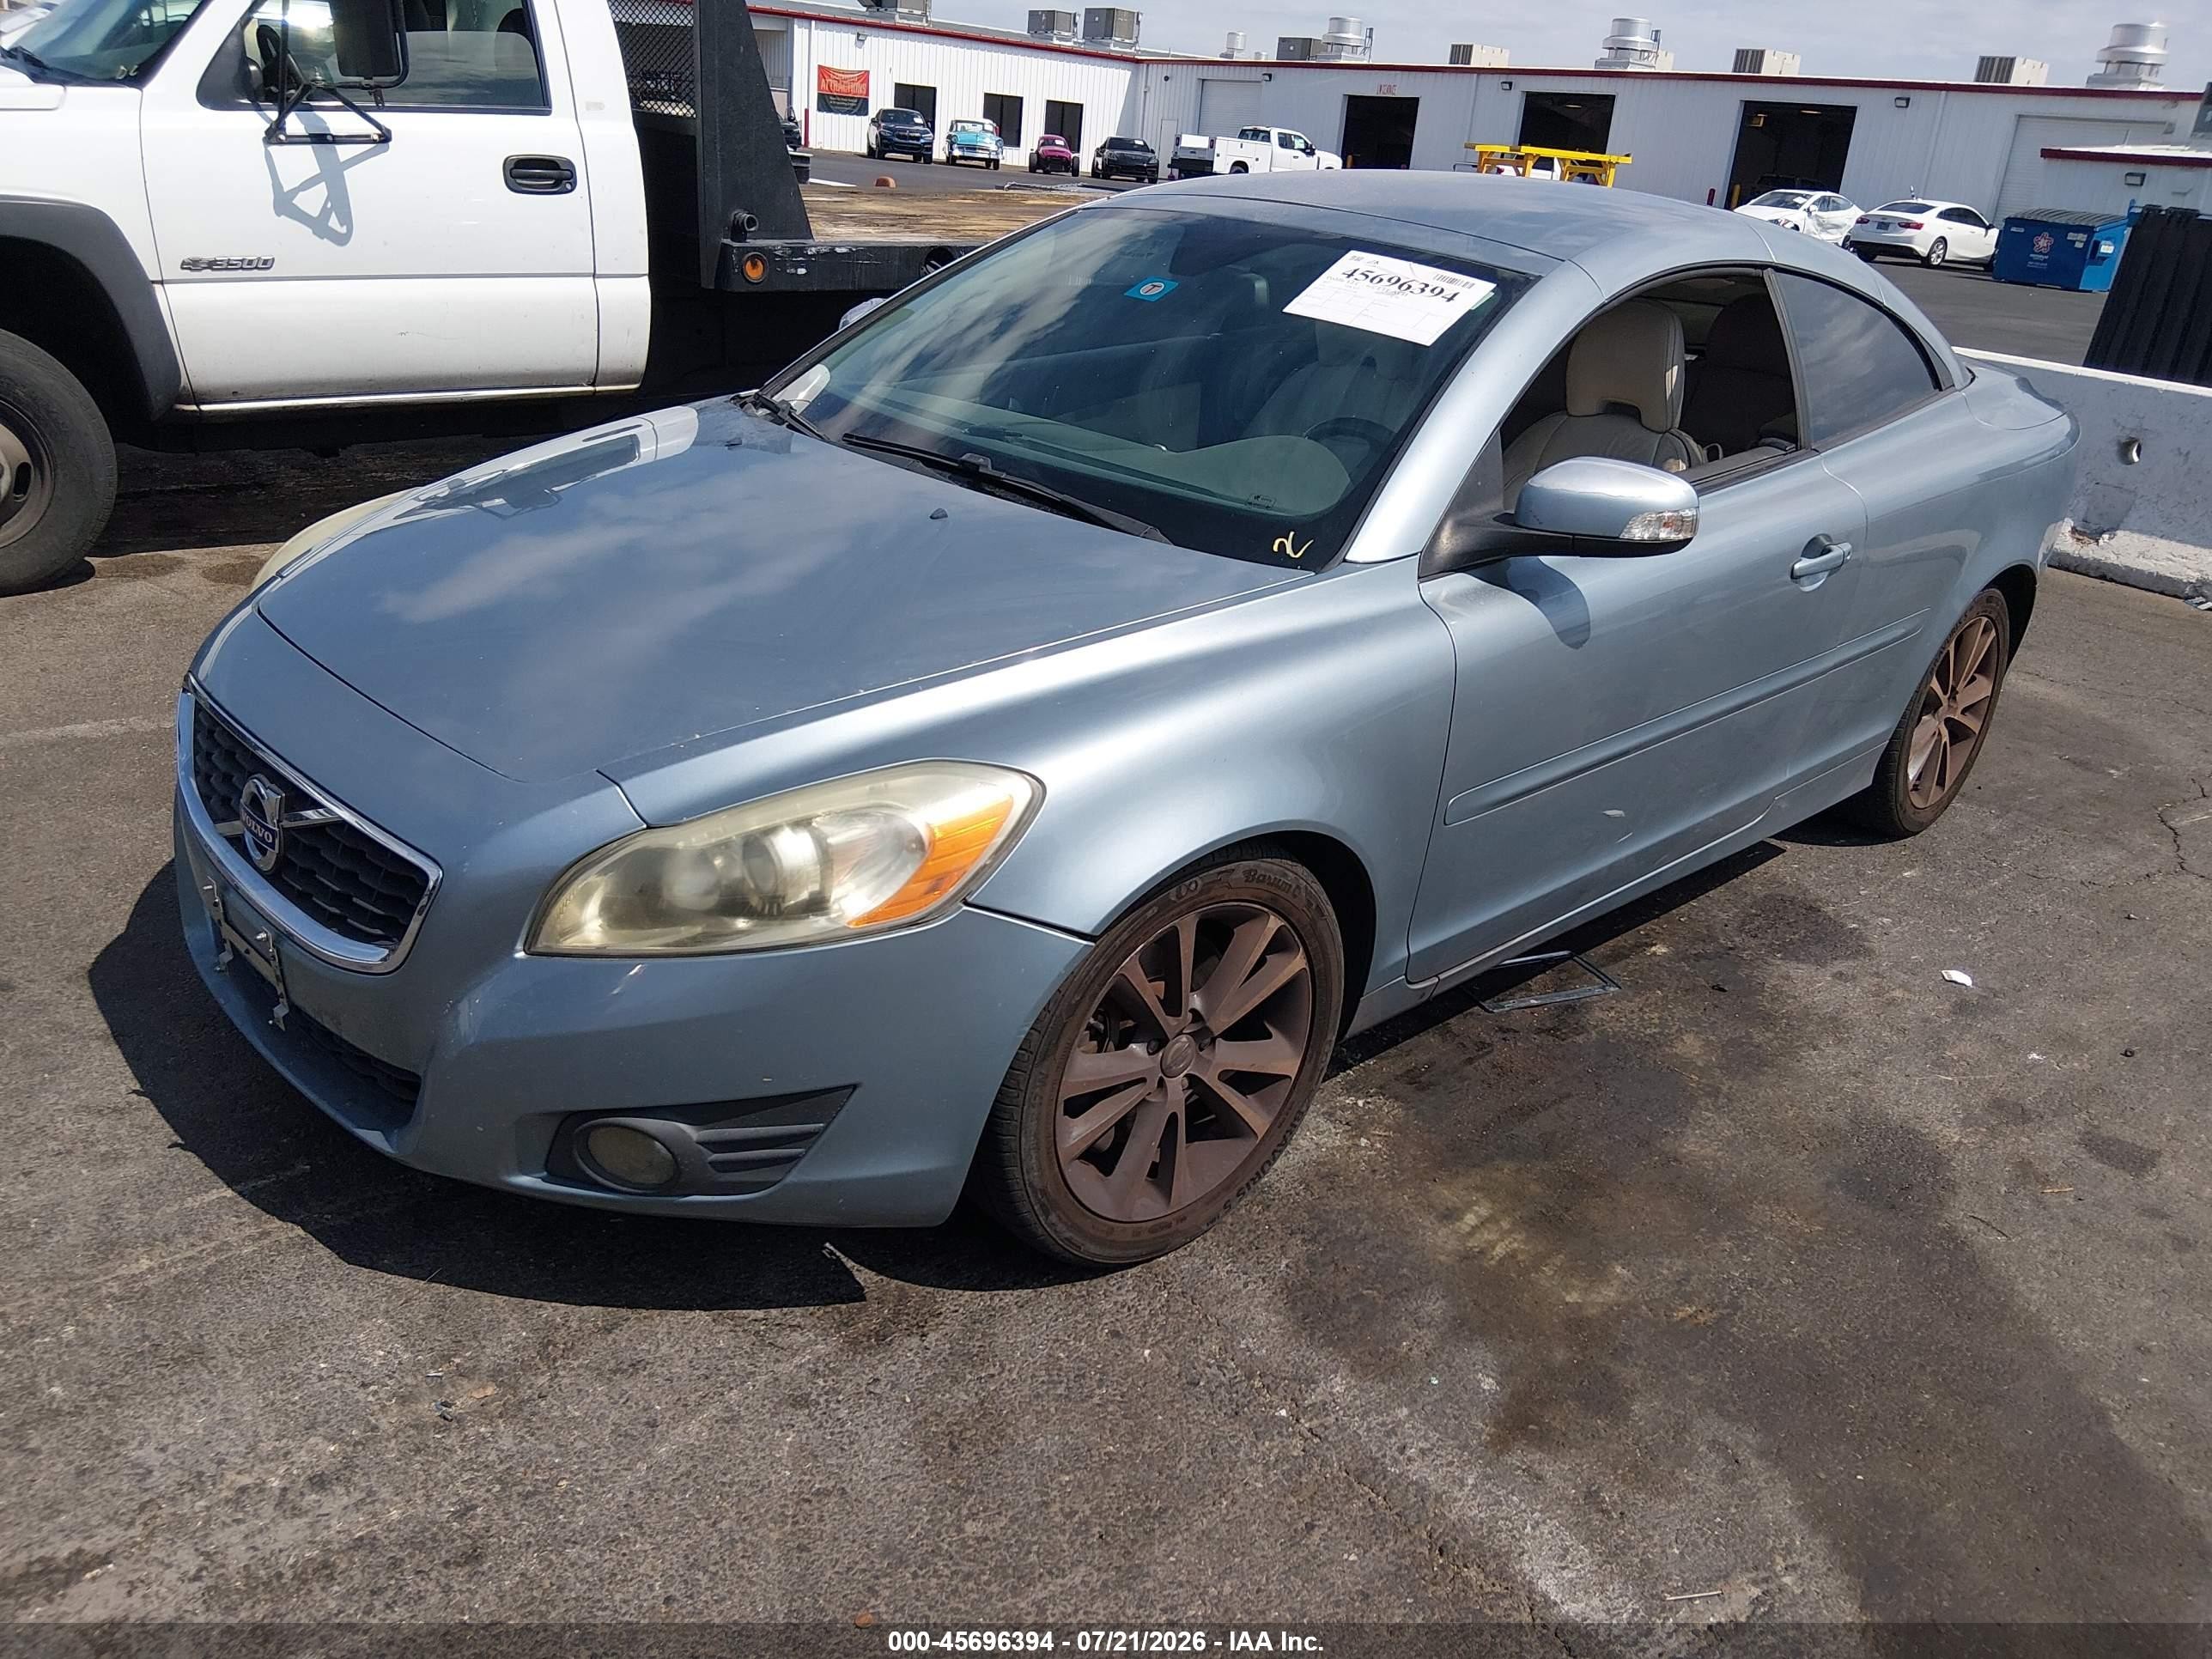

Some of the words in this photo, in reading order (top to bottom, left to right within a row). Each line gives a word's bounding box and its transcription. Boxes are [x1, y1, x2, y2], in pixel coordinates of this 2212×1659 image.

[211, 257, 275, 270] 3500
[1342, 268, 1460, 302] 45696394
[242, 811, 273, 843] VOLVO
